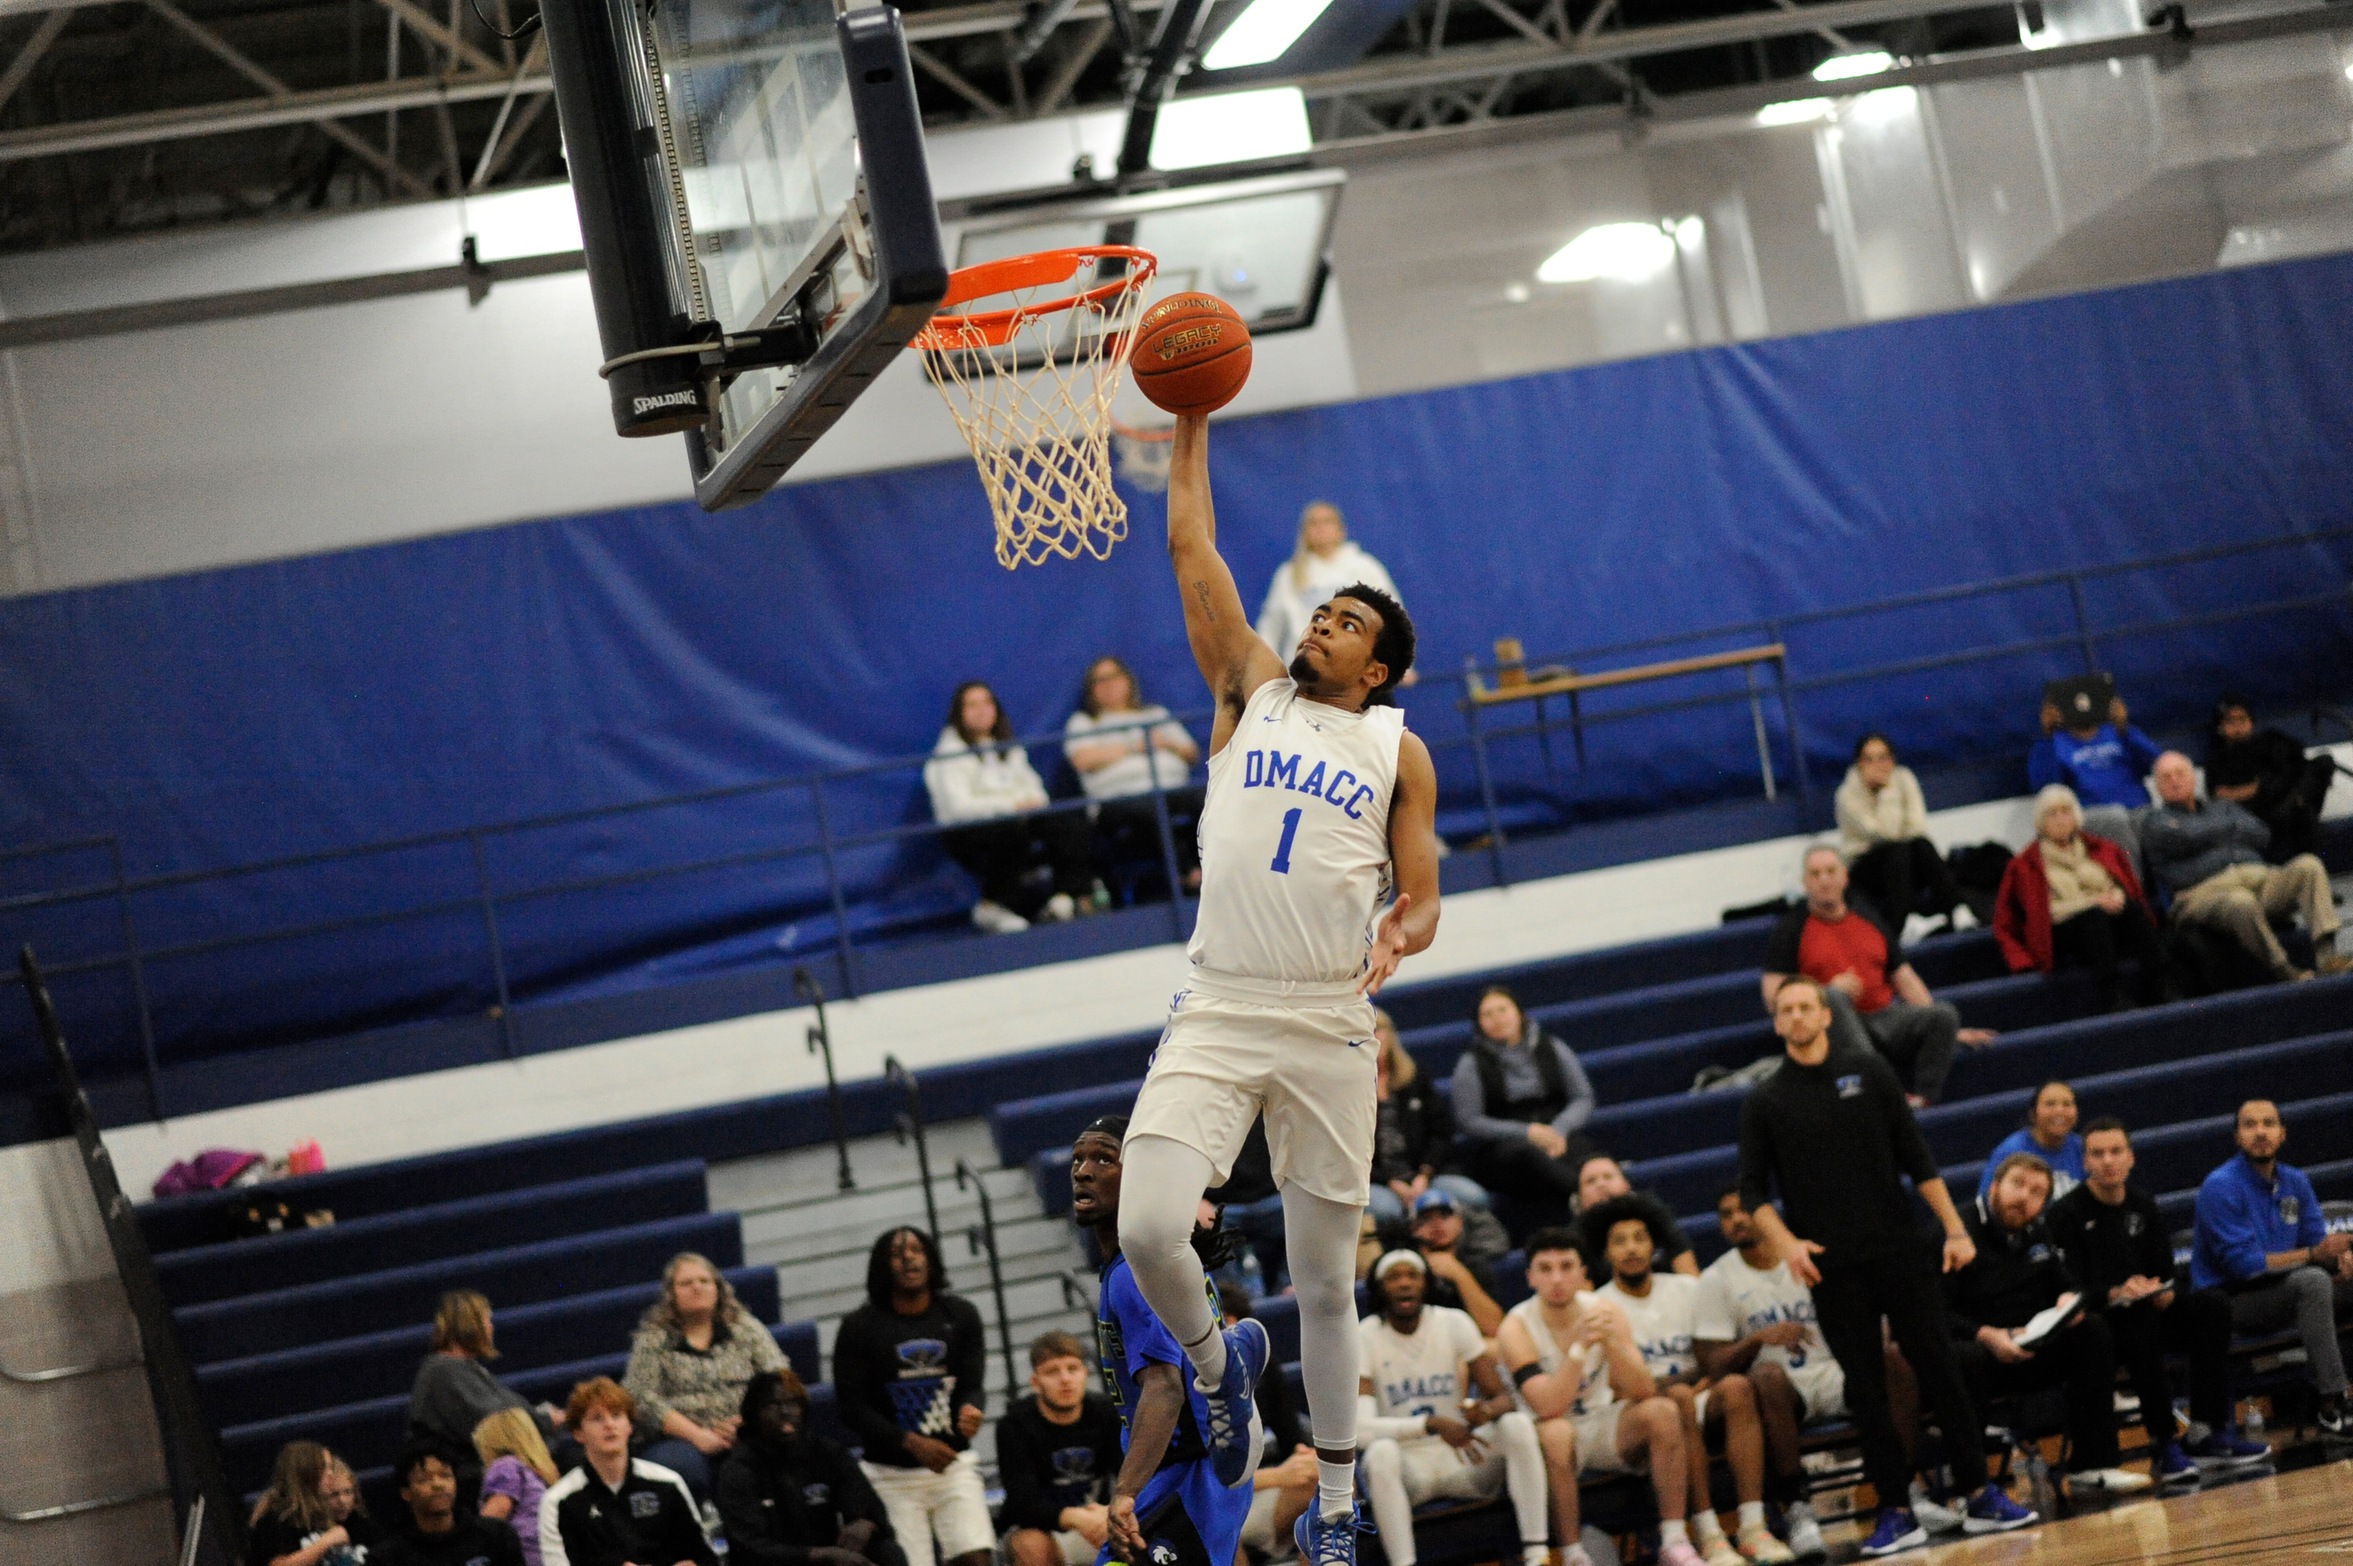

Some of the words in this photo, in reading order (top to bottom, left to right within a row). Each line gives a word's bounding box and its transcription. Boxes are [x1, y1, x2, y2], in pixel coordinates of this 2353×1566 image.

[1152, 323, 1221, 353] LEGACY
[633, 389, 697, 415] SPALDING
[1243, 749, 1374, 820] DMACC
[1270, 807, 1303, 875] 1
